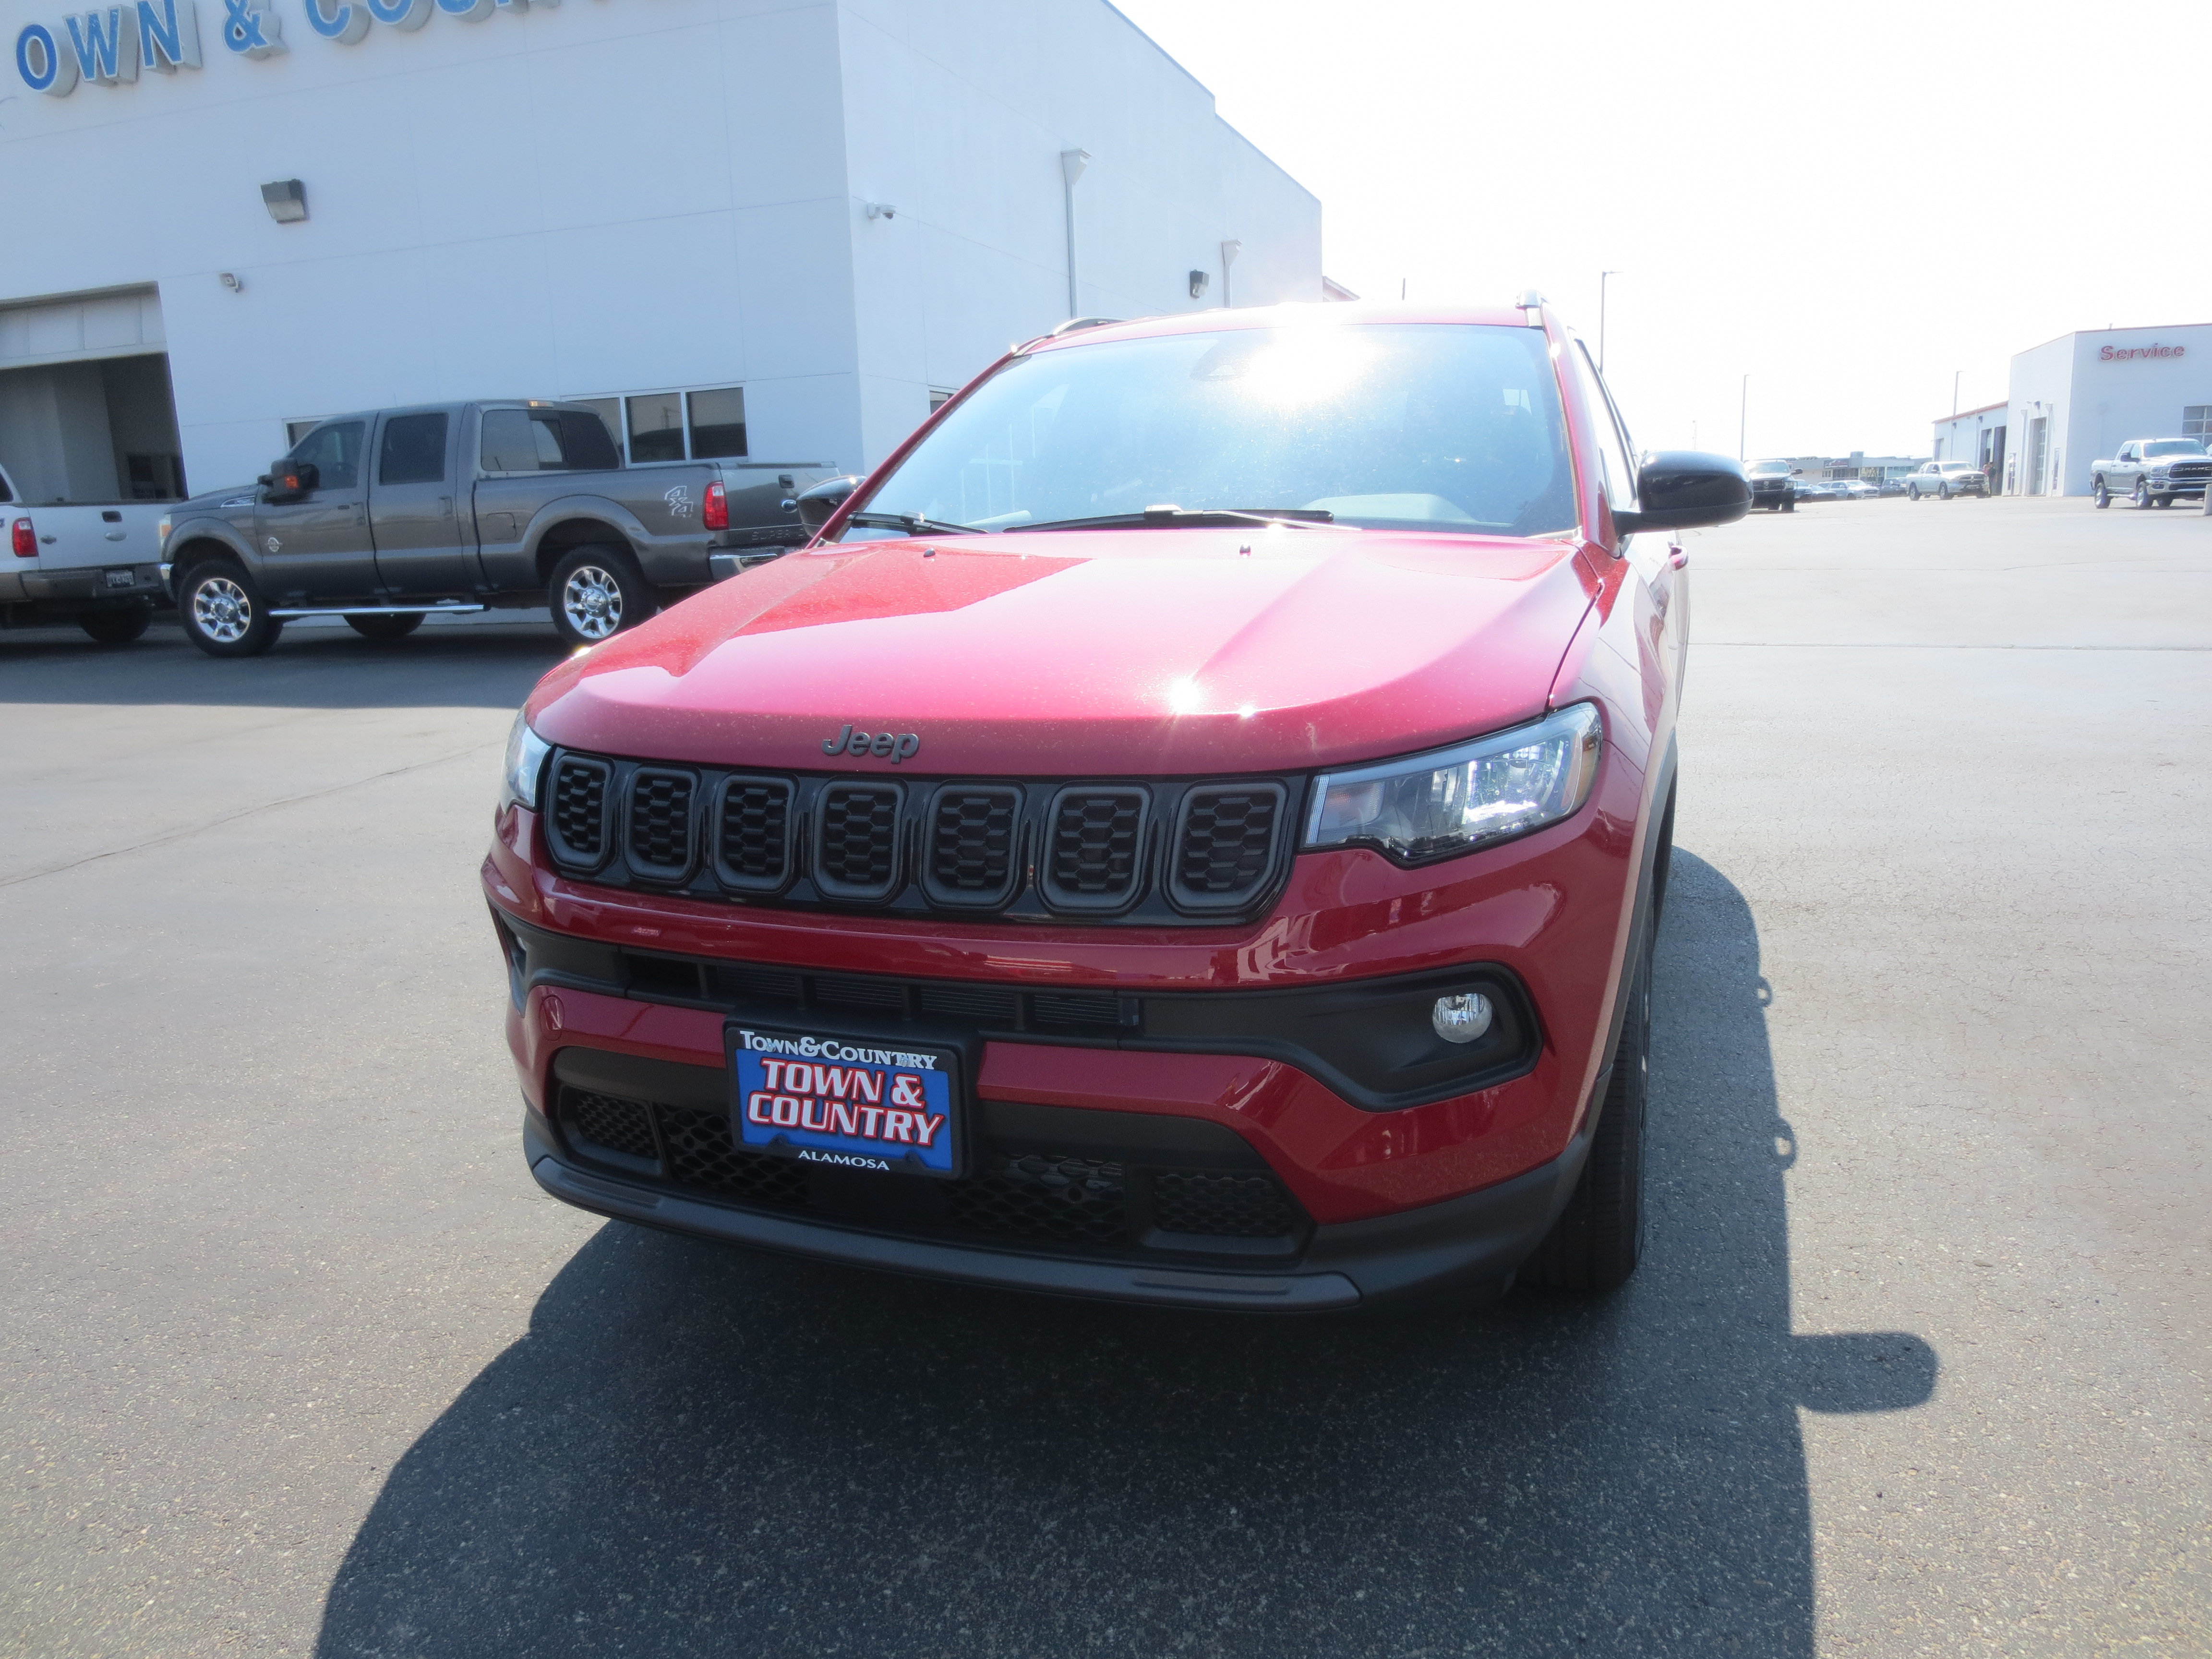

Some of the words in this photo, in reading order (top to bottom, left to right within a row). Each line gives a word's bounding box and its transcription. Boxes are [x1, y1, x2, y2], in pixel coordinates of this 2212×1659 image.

[222, 0, 271, 54] &
[2100, 342, 2186, 361] Service
[821, 724, 920, 764] Jeep
[760, 1058, 885, 1102] TOWN
[891, 1073, 926, 1108] &
[747, 1092, 944, 1146] COUNTRY
[798, 1150, 890, 1170] ALAMOSA
